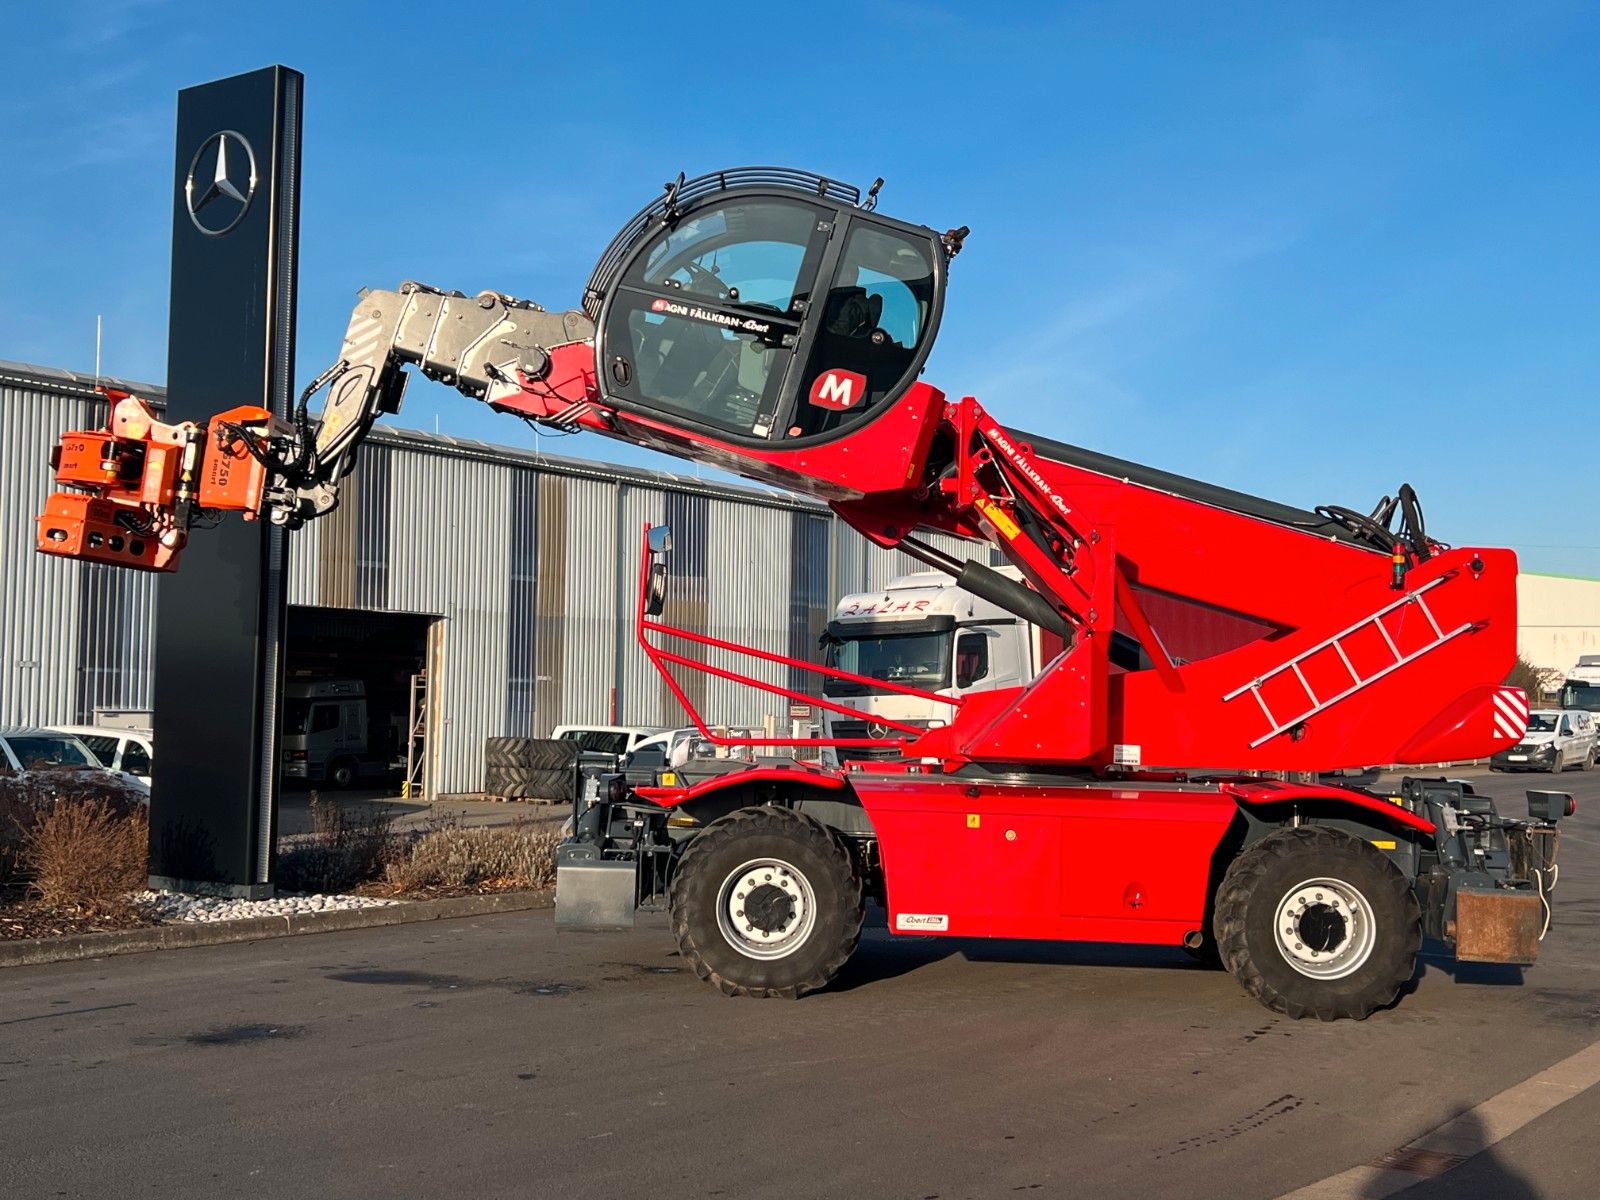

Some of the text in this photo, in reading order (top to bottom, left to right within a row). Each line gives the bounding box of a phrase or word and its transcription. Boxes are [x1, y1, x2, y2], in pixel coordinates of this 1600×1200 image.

[654, 299, 688, 316] MAGNI
[818, 373, 853, 407] M
[987, 428, 1016, 456] MAGNI
